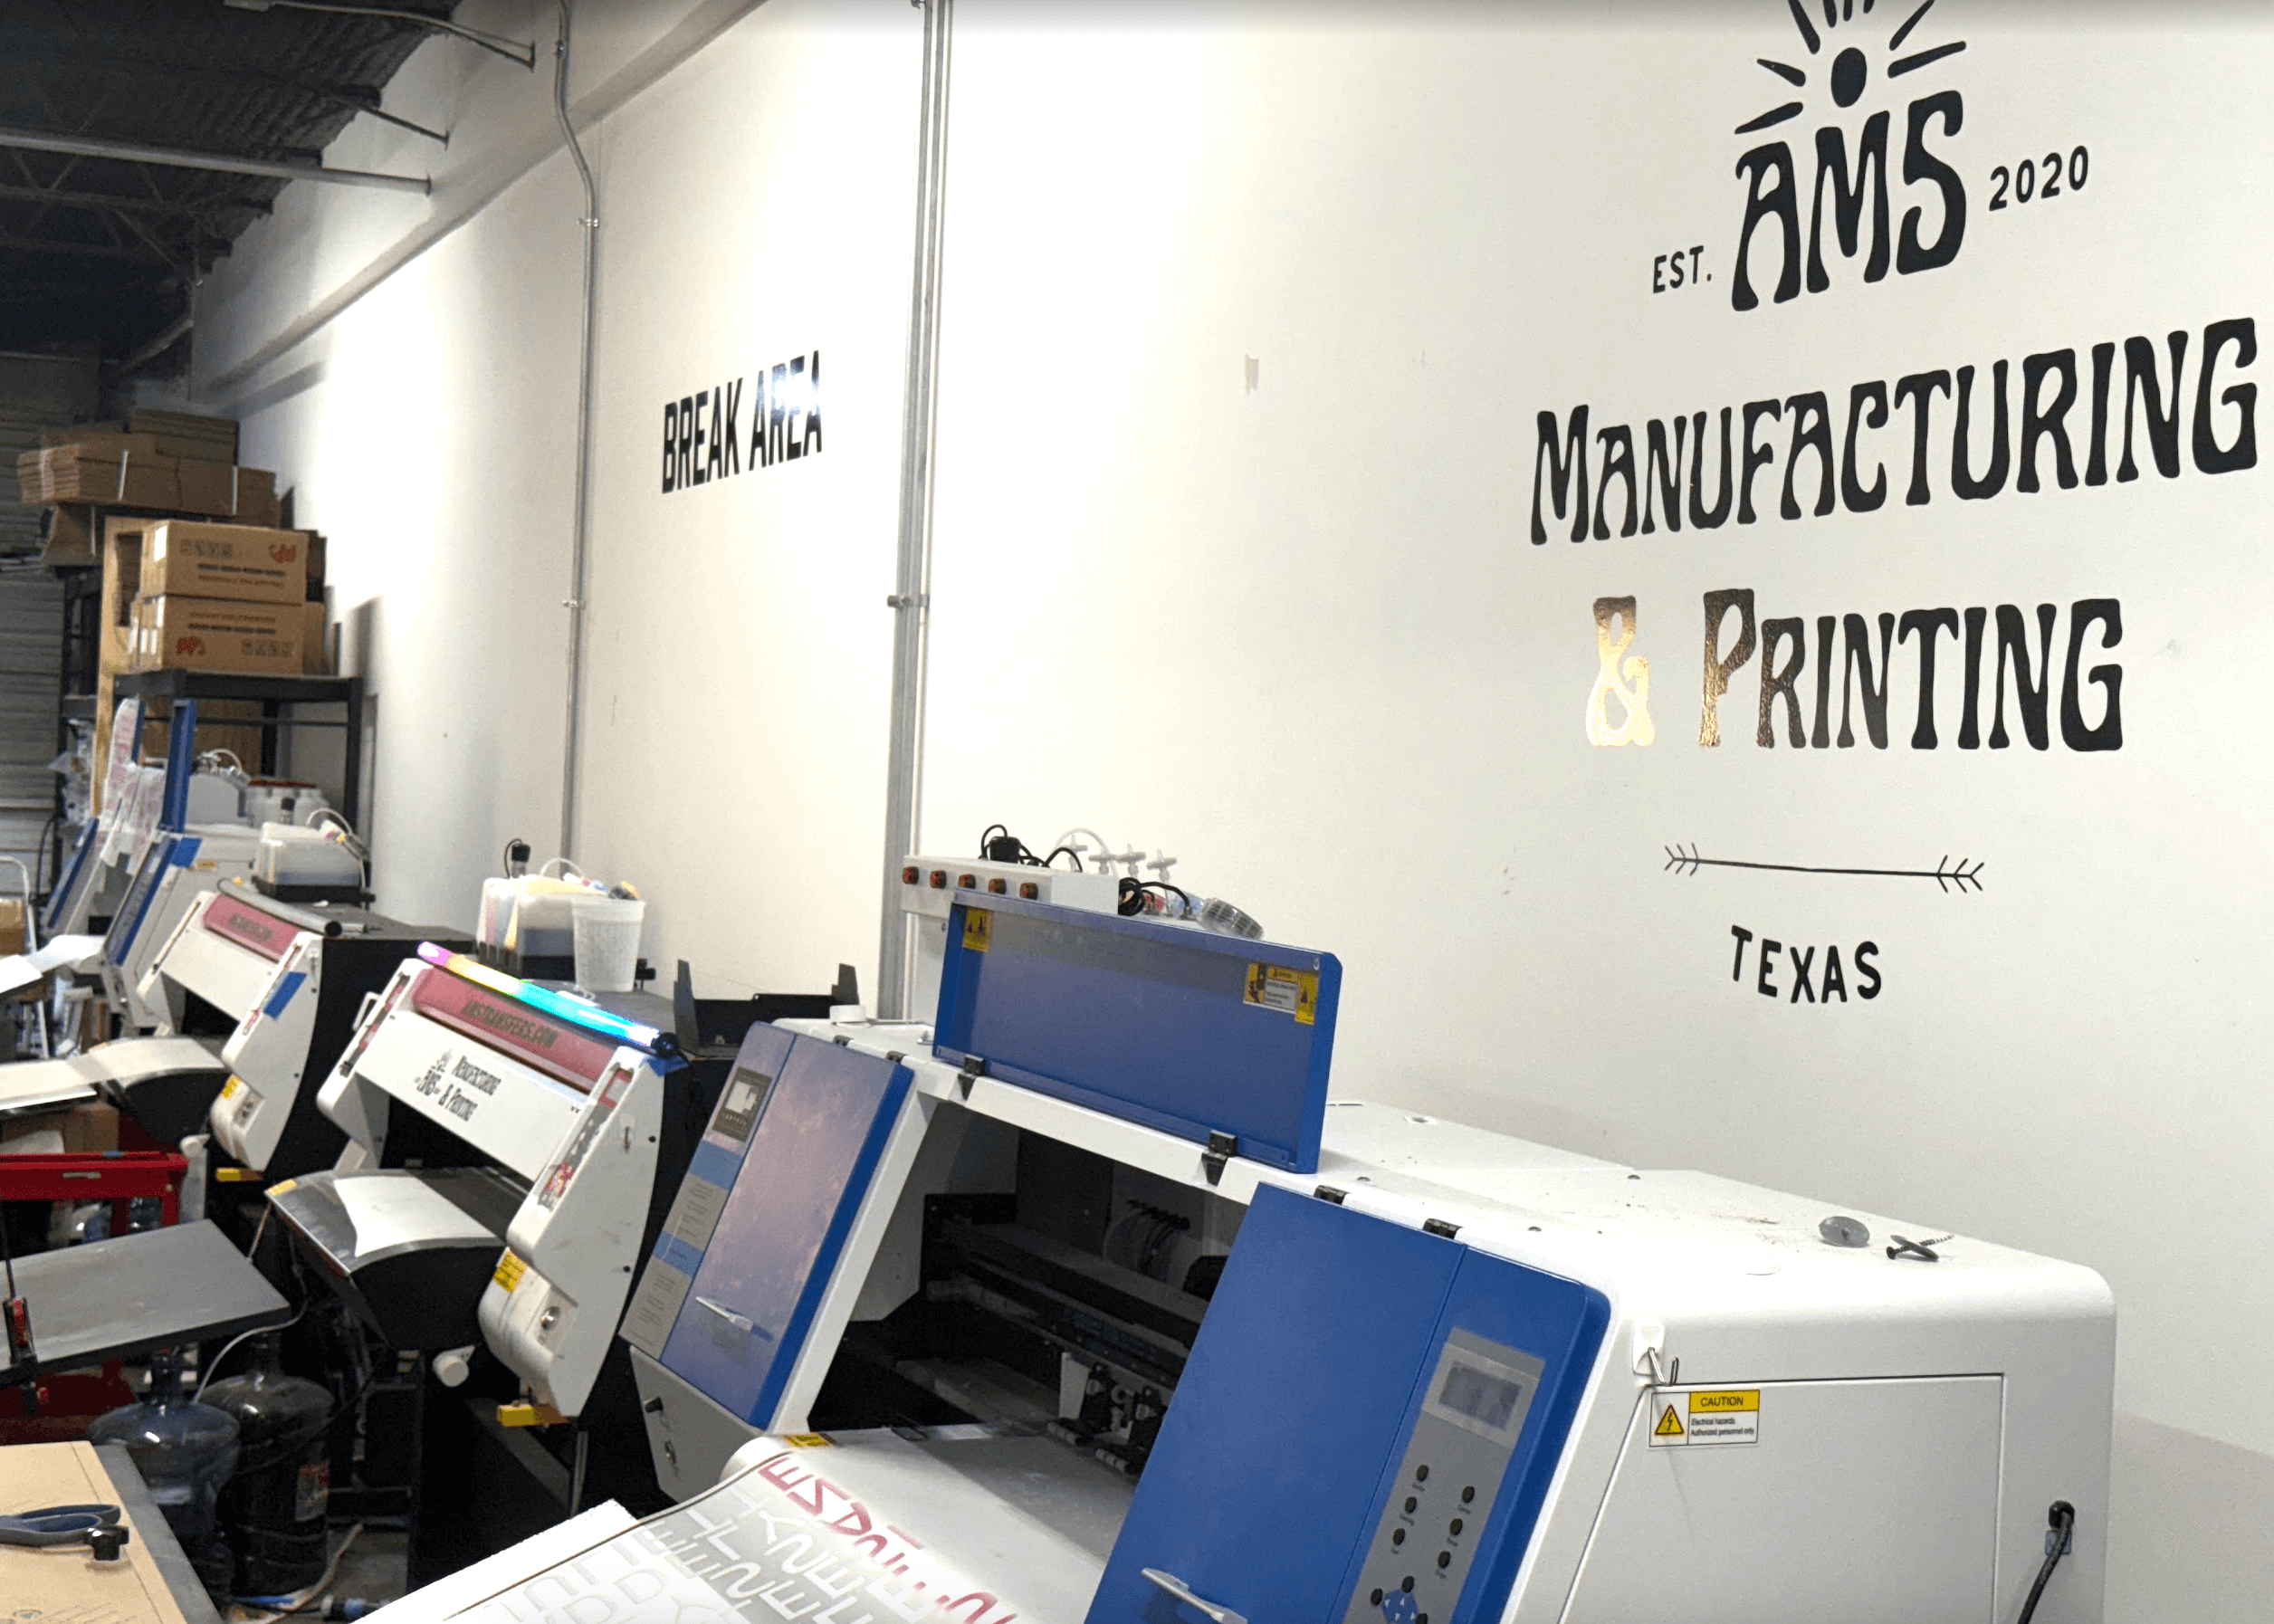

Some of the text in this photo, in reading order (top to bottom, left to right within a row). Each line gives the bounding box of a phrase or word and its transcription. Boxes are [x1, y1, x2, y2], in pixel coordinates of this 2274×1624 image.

[1652, 90, 2089, 312] EST. AMS 2020
[662, 349, 822, 494] BREAK AREA
[1531, 317, 2259, 546] MANUFACTURING
[1584, 588, 2124, 752] & PRINTING
[1731, 924, 1883, 1004] TEXAS
[1690, 1417, 1715, 1426] Electrical
[1700, 1396, 1744, 1408] CAUTION
[1718, 1428, 1744, 1438] personnel
[1744, 1427, 1755, 1436] only
